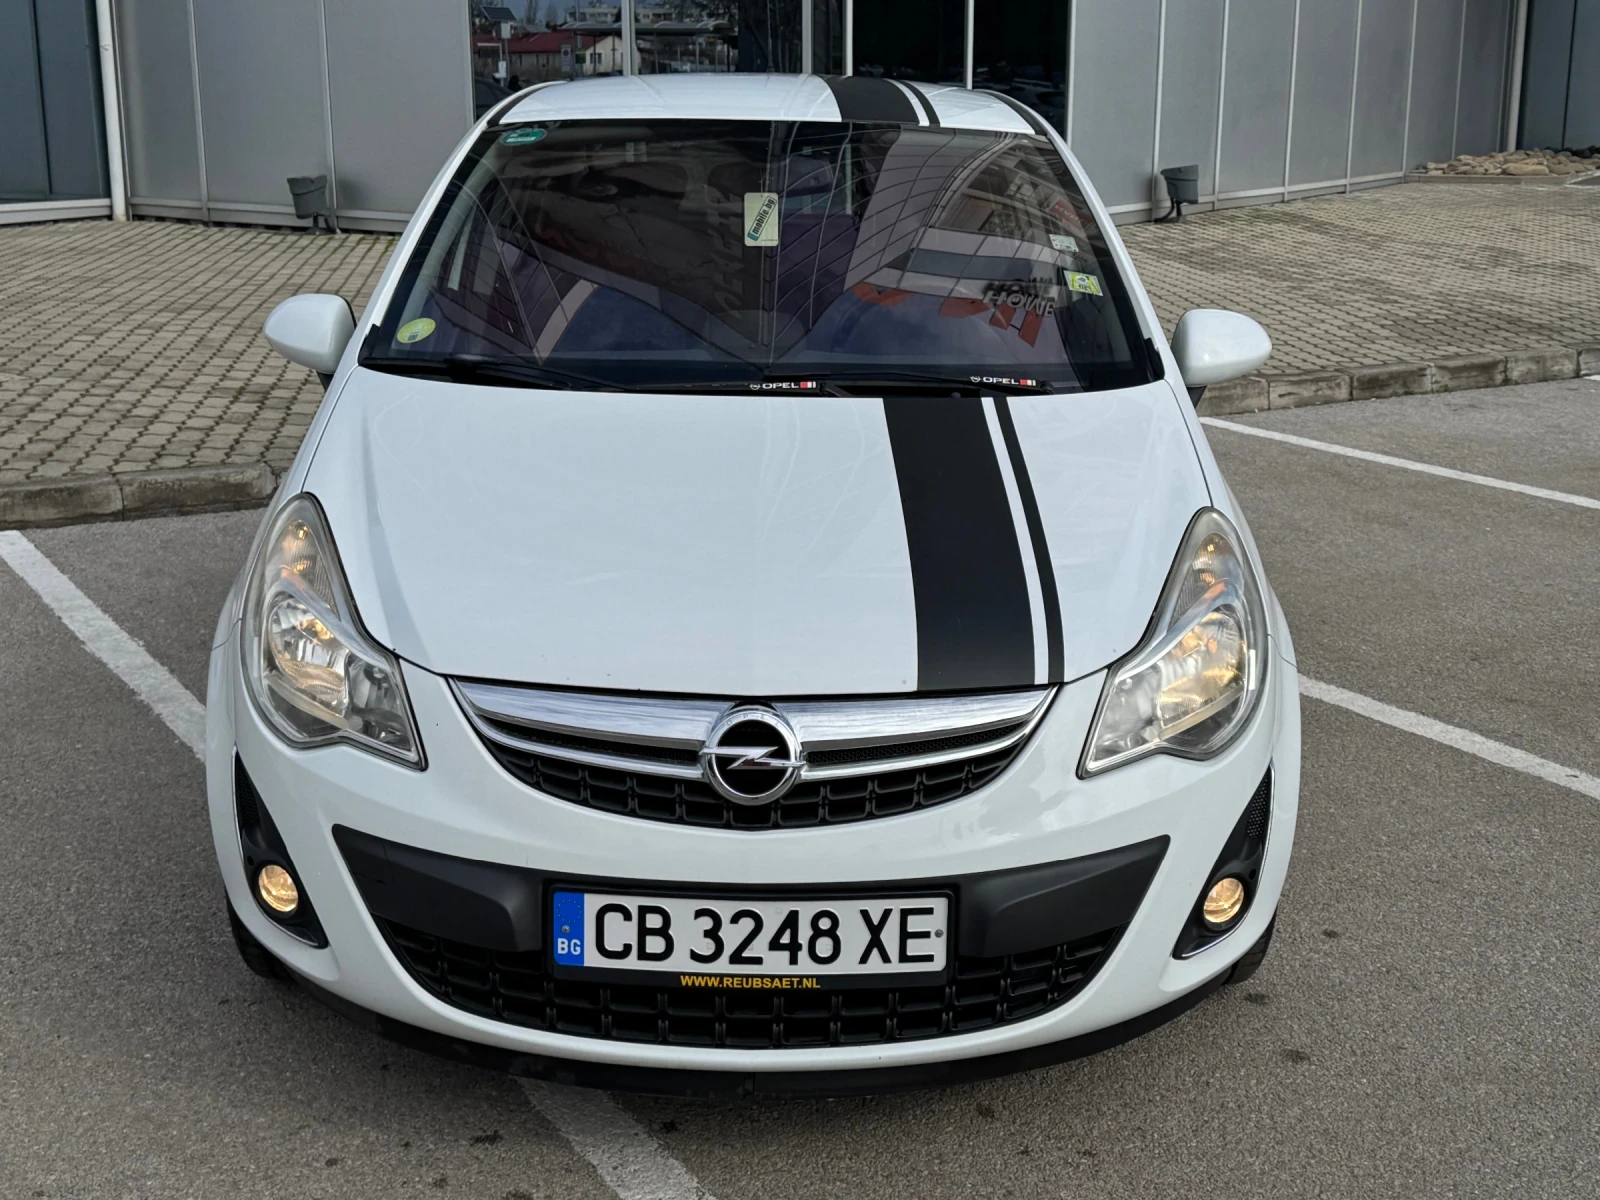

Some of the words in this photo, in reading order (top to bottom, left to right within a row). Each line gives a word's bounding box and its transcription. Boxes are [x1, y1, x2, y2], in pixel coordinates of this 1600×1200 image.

[751, 198, 777, 235] mobile.bg
[762, 381, 800, 389] OPEL
[982, 376, 1020, 385] OPEL
[595, 902, 675, 962] CB
[689, 908, 842, 966] 3248
[858, 906, 935, 965] XE
[557, 938, 581, 955] BG
[680, 975, 821, 988] WWW.REUBSAET.NL
